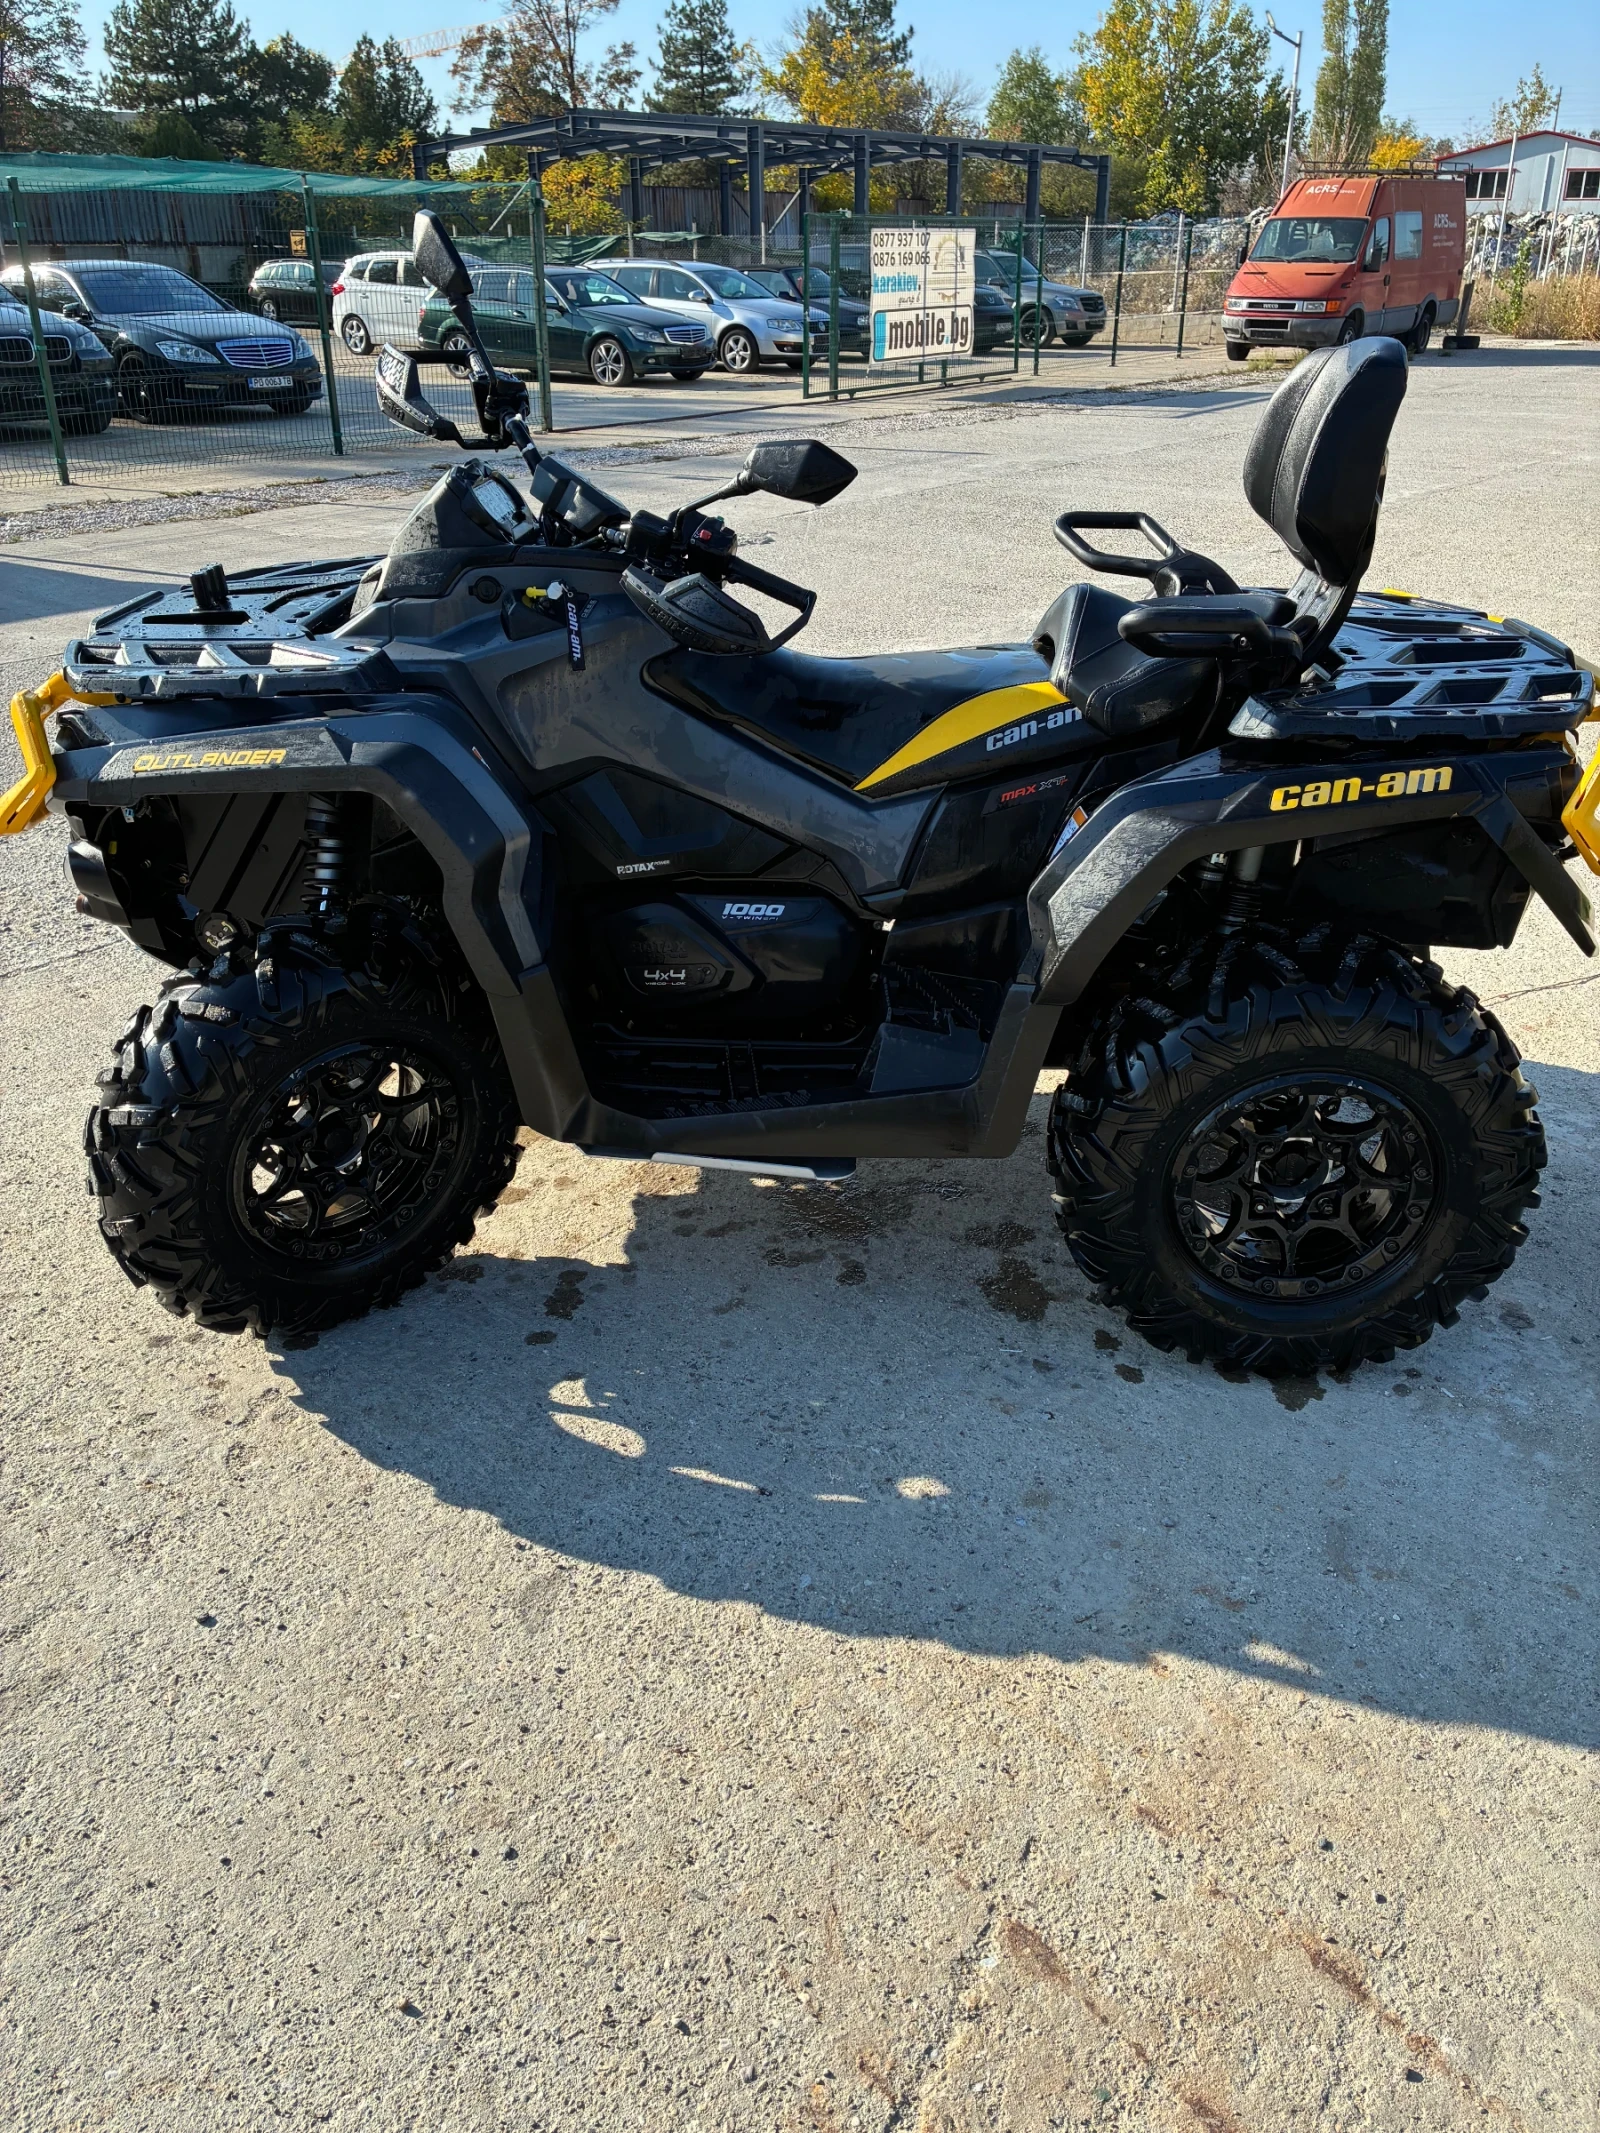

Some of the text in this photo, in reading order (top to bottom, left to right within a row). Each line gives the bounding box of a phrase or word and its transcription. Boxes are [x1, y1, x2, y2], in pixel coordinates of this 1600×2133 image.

[1305, 184, 1339, 195] ACRS
[1433, 213, 1449, 229] ACRS
[873, 232, 931, 248] 0877 937 107
[873, 251, 931, 267] 0876 169 066
[889, 311, 969, 350] mobile.bg
[567, 602, 581, 661] can-am
[132, 749, 287, 772] OUTLANDER
[1001, 784, 1037, 803] MAX
[1270, 766, 1453, 812] can-am
[617, 861, 656, 875] ROTAX
[722, 903, 786, 917] 1000
[643, 969, 686, 981] 4x4
